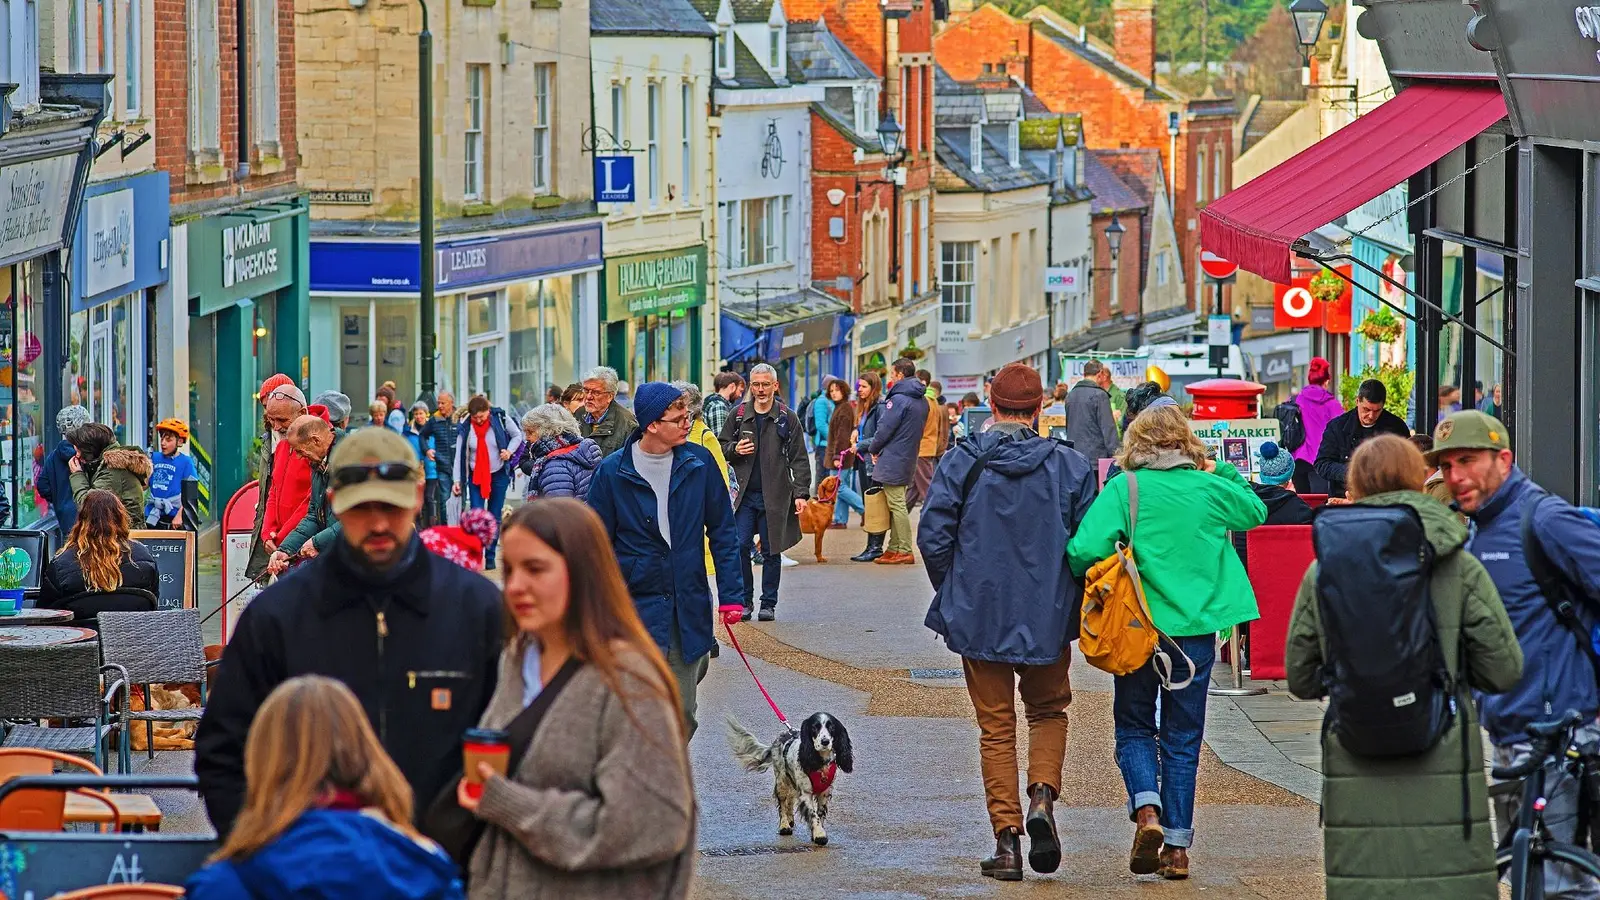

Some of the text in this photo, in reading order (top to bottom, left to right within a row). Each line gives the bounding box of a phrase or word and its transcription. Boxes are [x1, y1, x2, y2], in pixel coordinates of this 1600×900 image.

[601, 159, 631, 194] L
[338, 192, 369, 201] STREET
[234, 221, 271, 251] MOUNTAIN
[234, 247, 278, 283] WAREHOUSE
[437, 250, 449, 285] L
[451, 248, 487, 271] LEADERS
[371, 277, 411, 286] leaders.co.uk
[620, 254, 698, 296] HOLLAND & BARRETT
[1048, 275, 1074, 285] pdsa
[1111, 361, 1138, 376] TRUTH
[1227, 427, 1277, 438] MARKET
[107, 853, 146, 885] At
